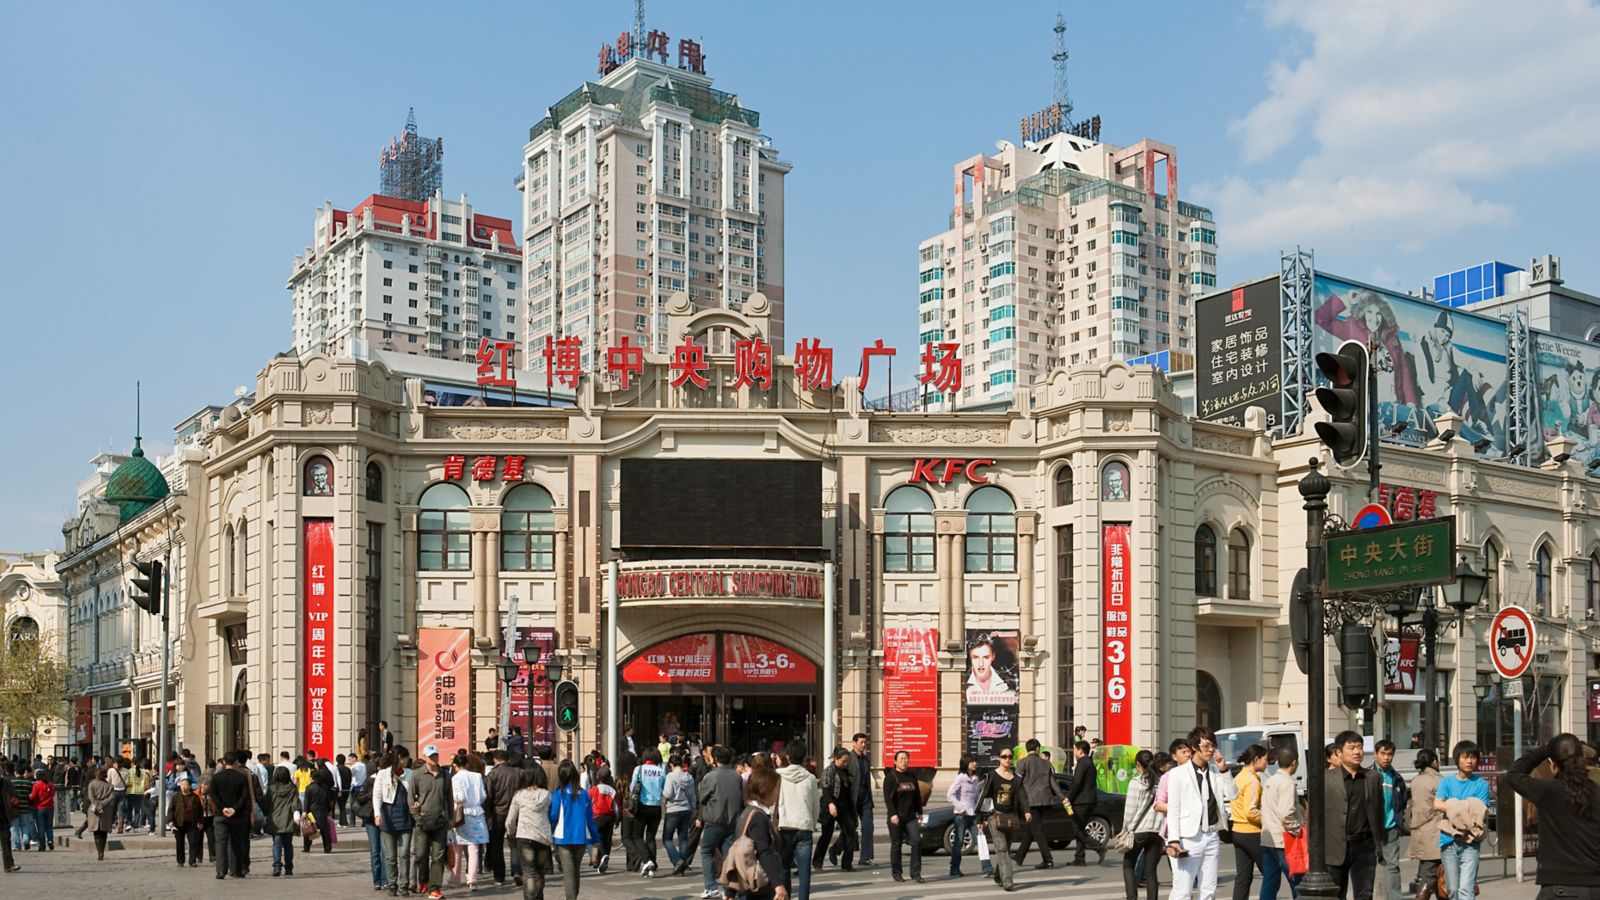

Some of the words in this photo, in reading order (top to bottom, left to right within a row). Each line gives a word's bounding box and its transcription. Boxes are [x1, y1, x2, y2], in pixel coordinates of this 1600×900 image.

[1211, 326, 1268, 353] 家居饰品
[475, 335, 962, 394] 红博中央购物广场
[1211, 343, 1268, 369] 住宅装修
[1211, 359, 1268, 385] 室内设计
[444, 455, 526, 481] 肯德基
[908, 458, 993, 483] KFC
[1340, 535, 1433, 567] 中央大街
[617, 572, 665, 597] HONGBO
[669, 571, 726, 595] CENTRAL
[732, 571, 792, 597] SHOPPING
[796, 573, 821, 598] MALL
[1111, 543, 1123, 606] 非常折扣日
[1344, 569, 1370, 582] ZHONG
[1374, 566, 1394, 577] YANG
[1412, 562, 1425, 574] JIE
[1106, 611, 1127, 622] 服饰
[1106, 626, 1127, 637] 鞋品
[1400, 659, 1415, 667] KFC
[435, 676, 443, 701] SEGO
[442, 675, 456, 739] 申格体育
[434, 703, 443, 740] SPORTS
